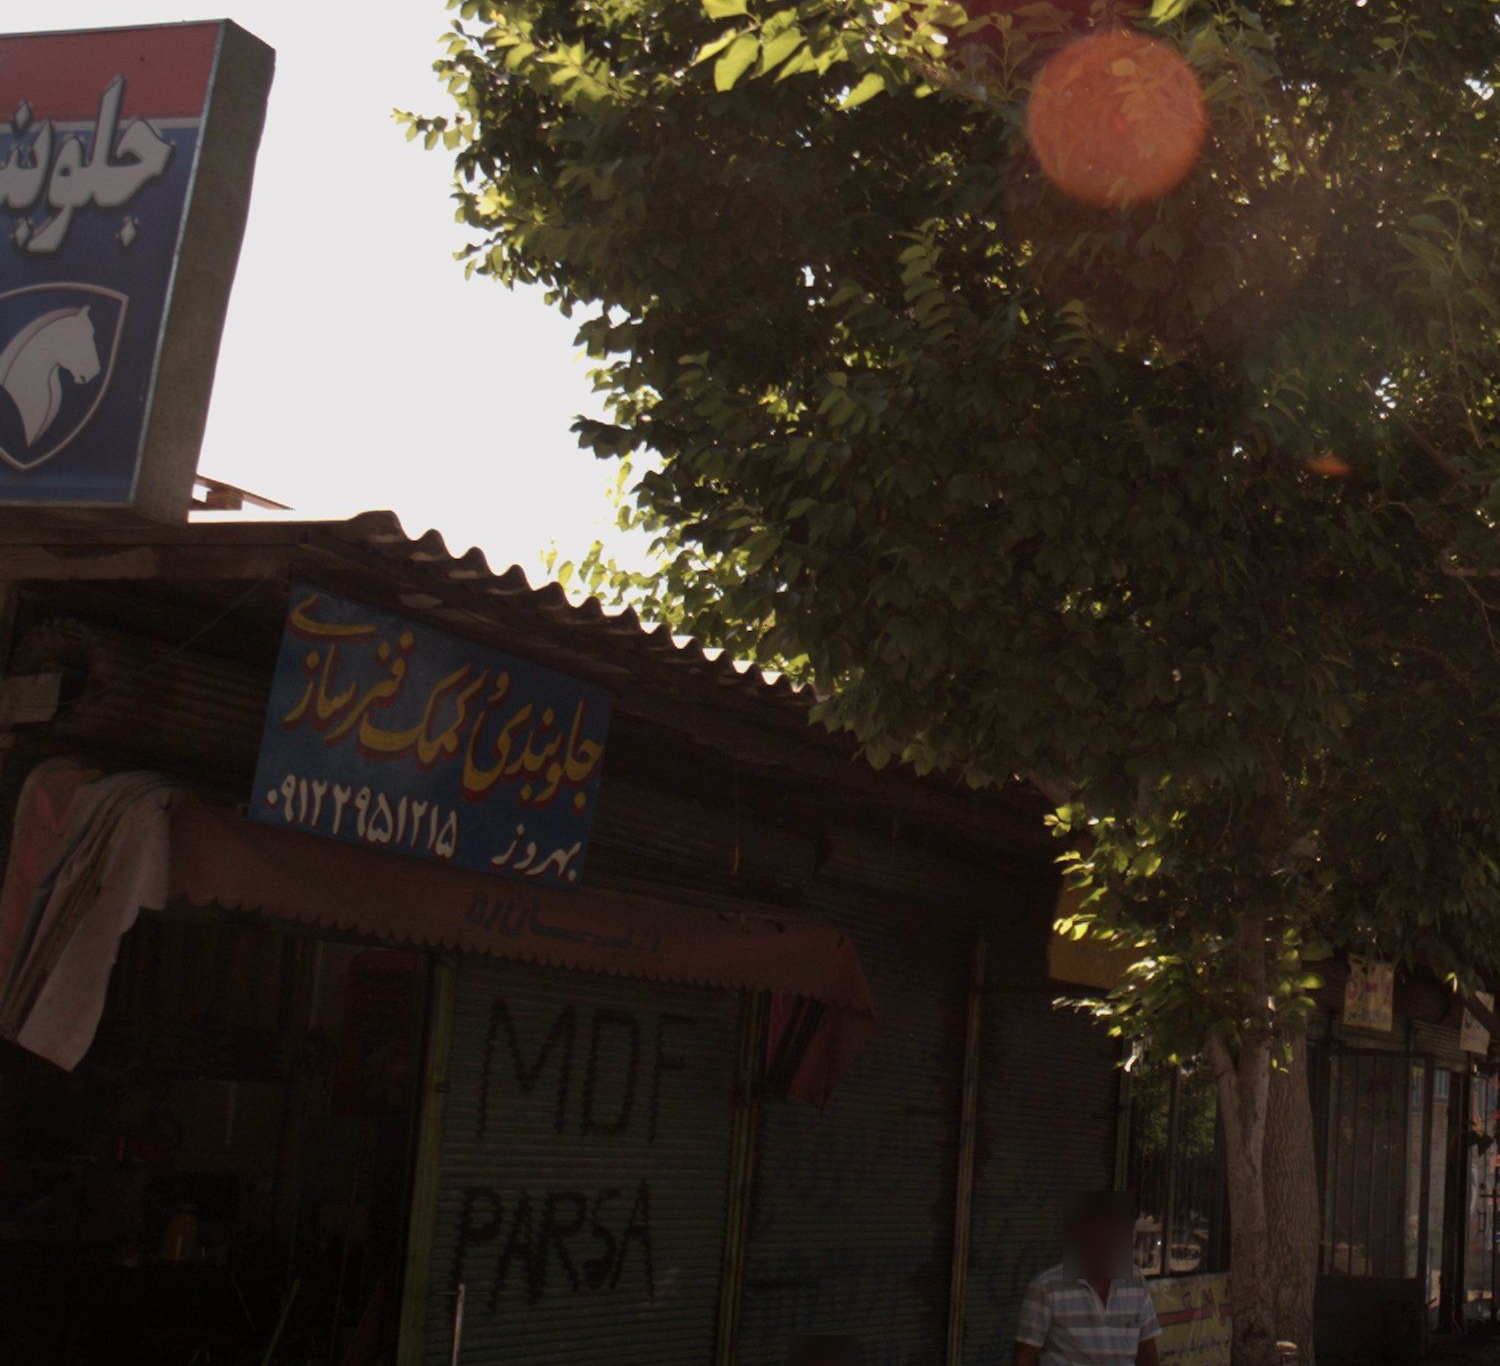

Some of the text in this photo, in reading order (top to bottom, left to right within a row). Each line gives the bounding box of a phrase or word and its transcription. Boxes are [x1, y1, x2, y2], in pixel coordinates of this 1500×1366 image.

[490, 823, 582, 882] بهروز
[474, 997, 697, 1140] MDF
[450, 1179, 655, 1311] PARSA
